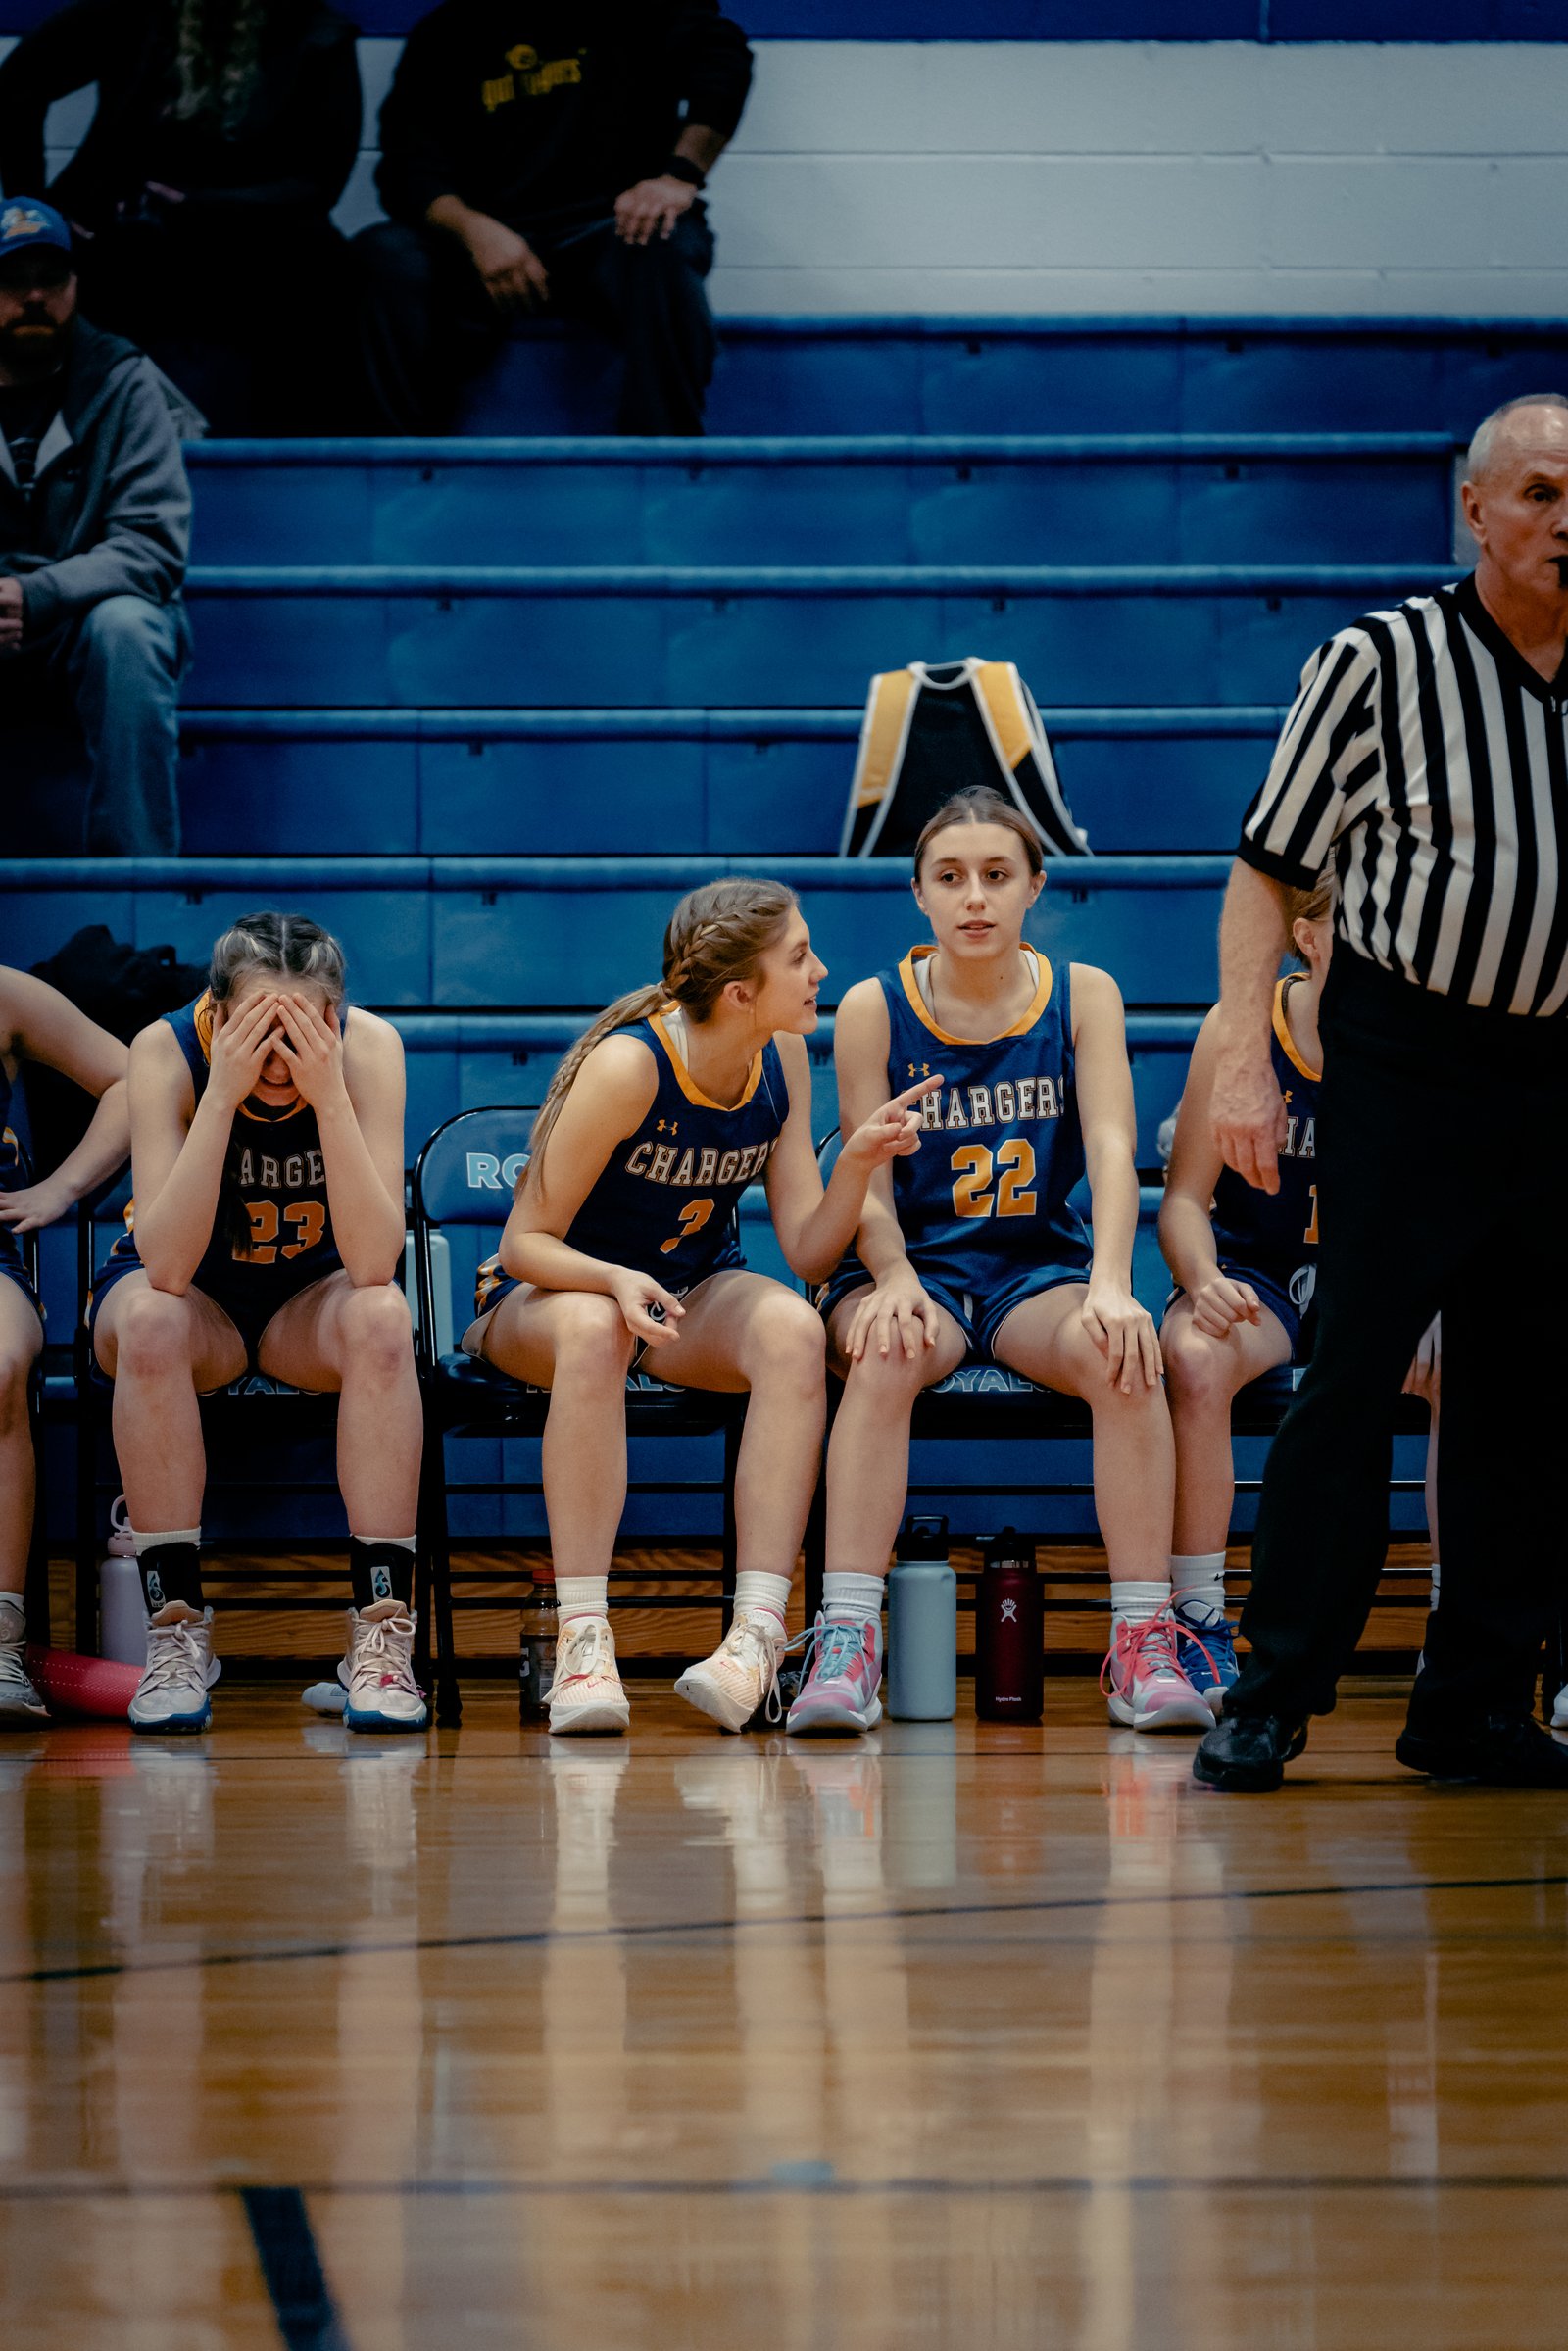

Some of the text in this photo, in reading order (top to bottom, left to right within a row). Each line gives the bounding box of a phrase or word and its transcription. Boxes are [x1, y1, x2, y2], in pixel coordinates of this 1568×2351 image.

[903, 1075, 1064, 1131] HARGER
[624, 1137, 780, 1187] CHARGER
[951, 1138, 1037, 1217] 22
[232, 1200, 326, 1265] 23
